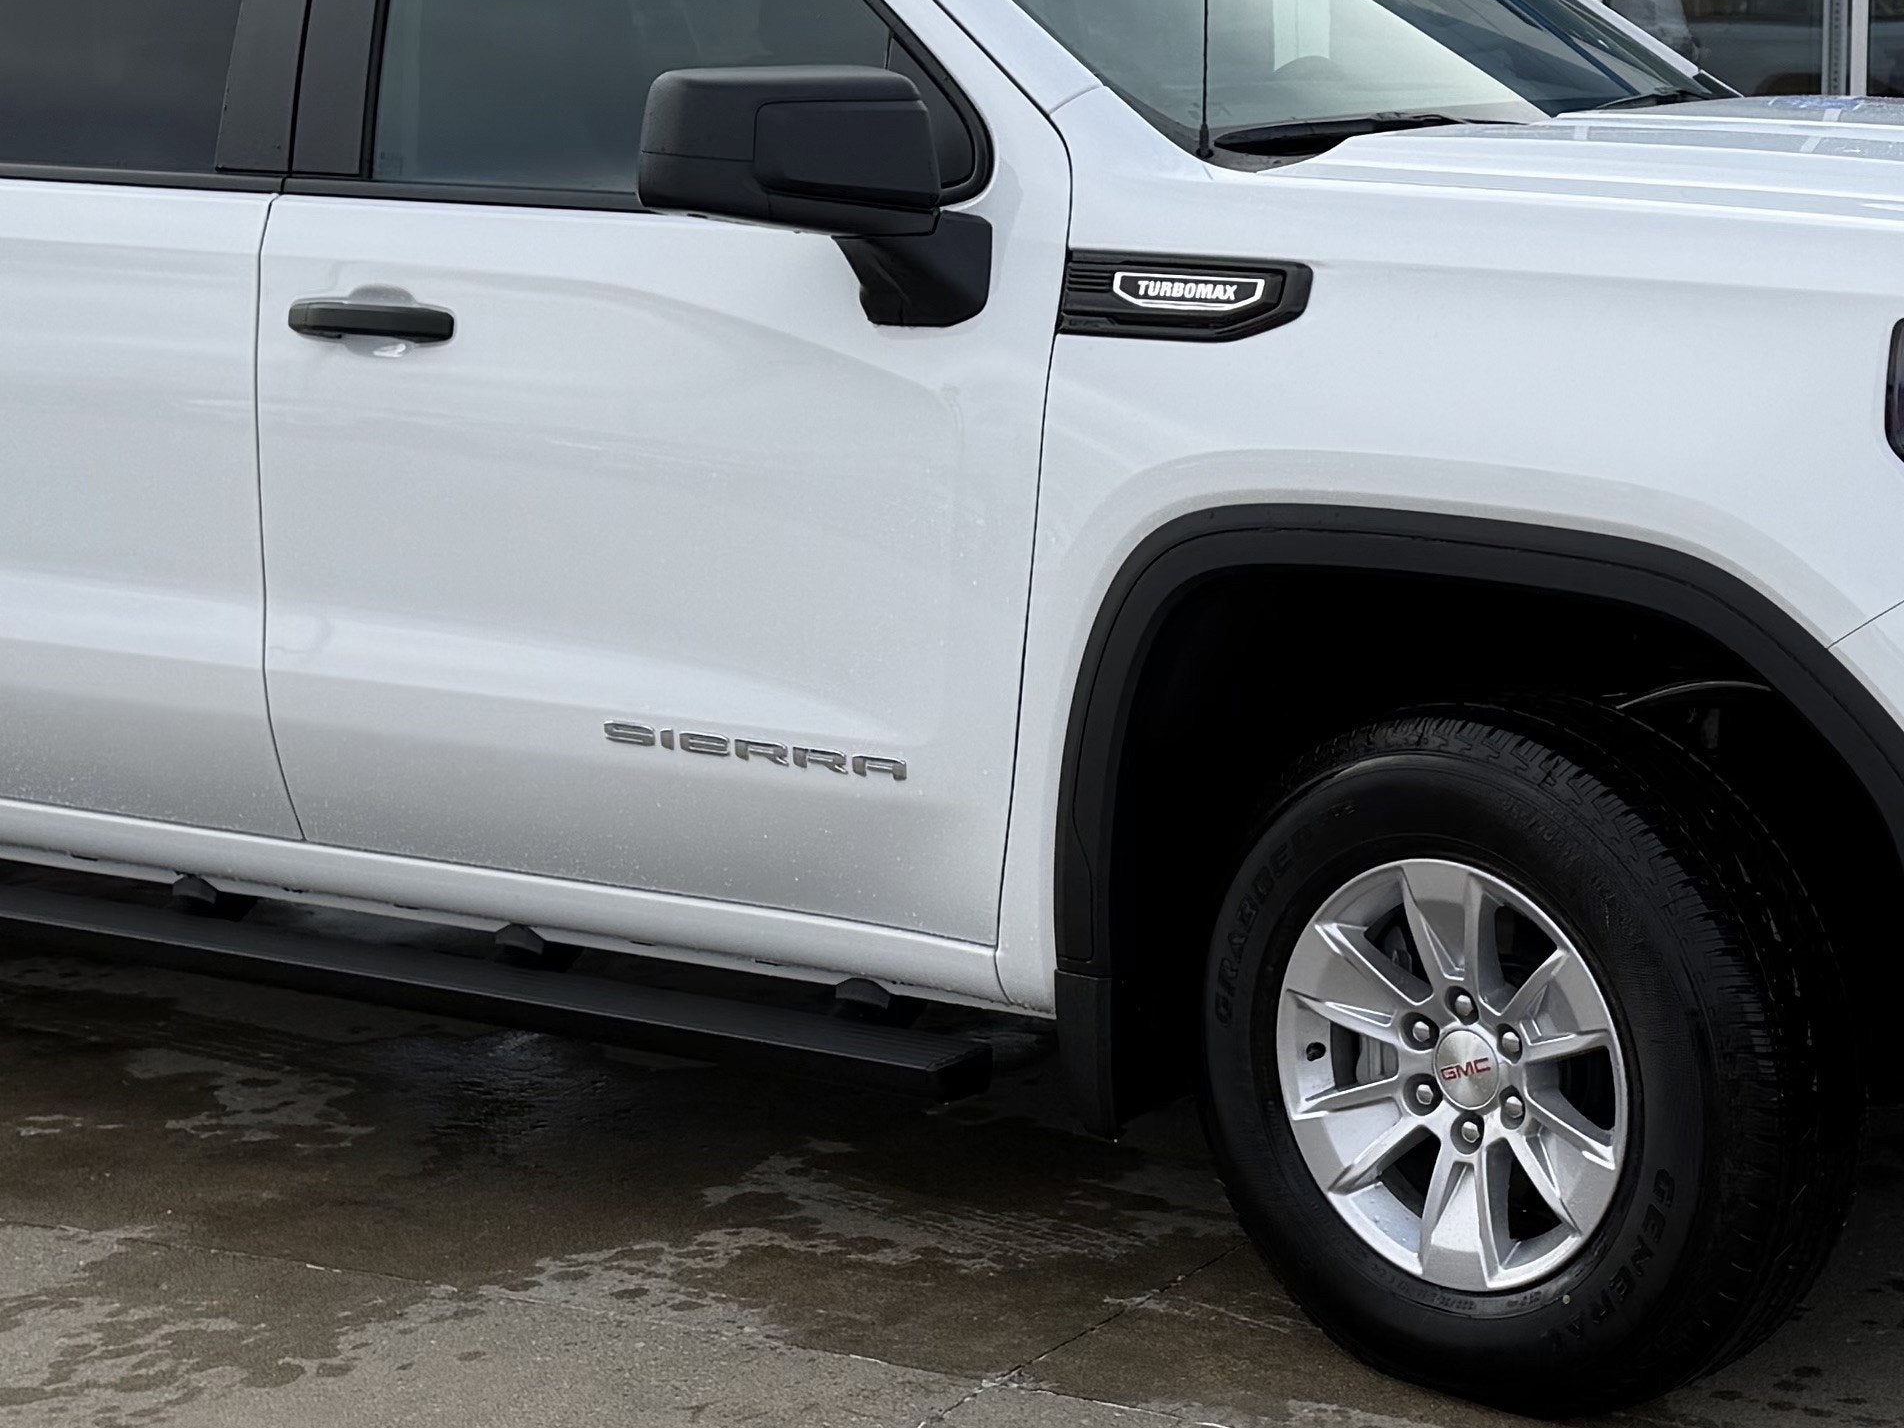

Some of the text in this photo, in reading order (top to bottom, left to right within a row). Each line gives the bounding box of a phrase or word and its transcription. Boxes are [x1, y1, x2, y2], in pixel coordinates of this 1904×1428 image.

[1137, 280, 1238, 301] TURBOMAX
[602, 719, 907, 781] SIERRA
[1439, 1056, 1492, 1082] GMC
